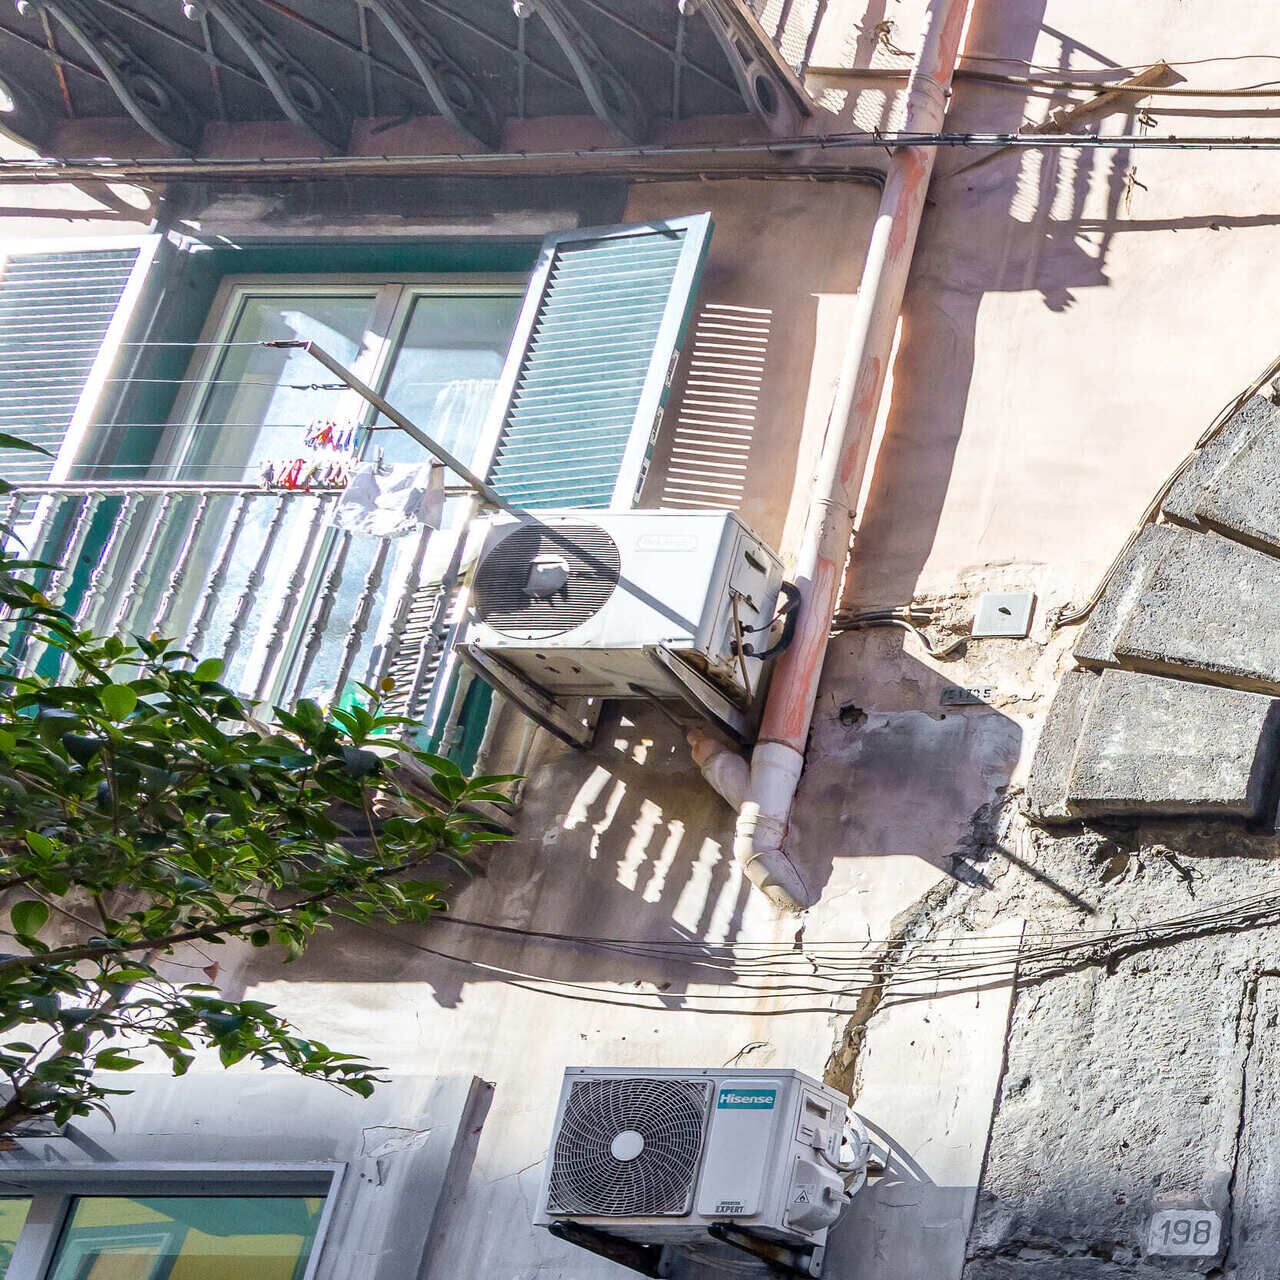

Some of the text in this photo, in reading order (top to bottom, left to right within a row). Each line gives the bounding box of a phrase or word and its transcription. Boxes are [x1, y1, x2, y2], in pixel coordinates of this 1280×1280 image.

[719, 1093, 774, 1104] Hisense
[715, 1205, 745, 1214] EXPERT
[1160, 1219, 1212, 1245] 198
